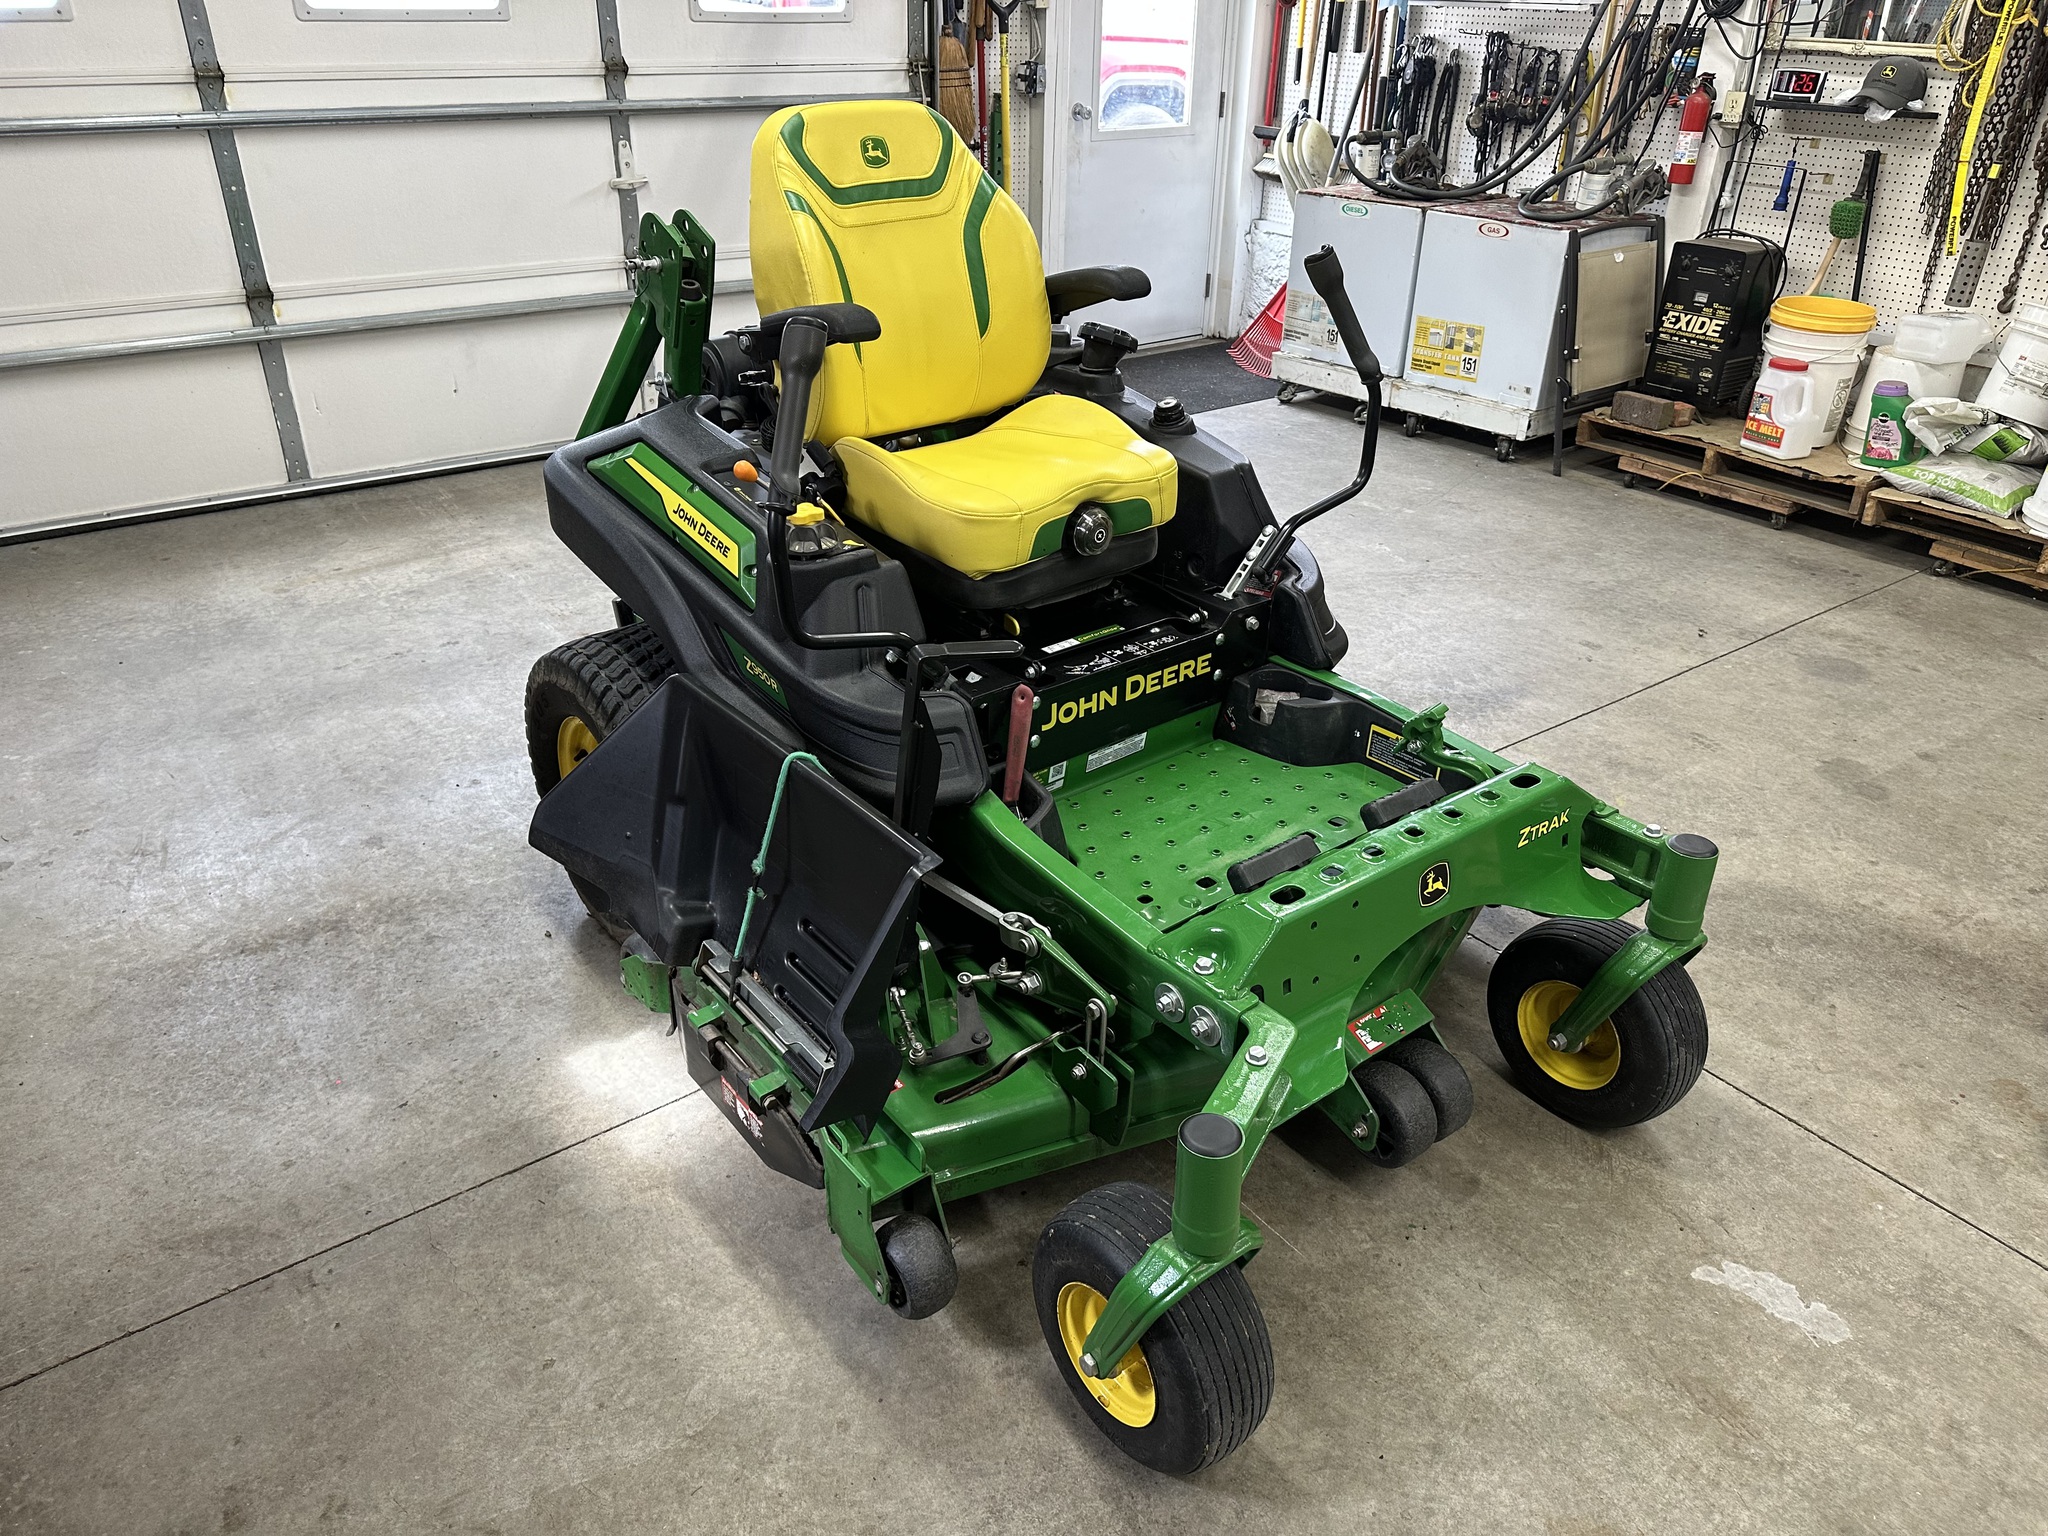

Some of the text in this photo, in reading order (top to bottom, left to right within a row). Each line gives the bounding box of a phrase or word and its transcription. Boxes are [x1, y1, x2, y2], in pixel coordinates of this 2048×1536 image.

[1345, 206, 1365, 215] DIESEL
[1486, 226, 1501, 235] GAS
[1662, 310, 1726, 337] EXIDE
[1326, 328, 1340, 343] 151
[1413, 346, 1461, 363] TRANSFER TANK
[1461, 356, 1477, 372] 151
[1745, 419, 1758, 431] ICE
[1758, 424, 1784, 438] MELT
[1912, 469, 1959, 490] TOP SOIL
[673, 503, 731, 559] JOHN DEERE
[743, 655, 779, 693] Z950R
[1041, 652, 1212, 732] JOHN DEERE
[1517, 808, 1571, 849] ZTRAK
